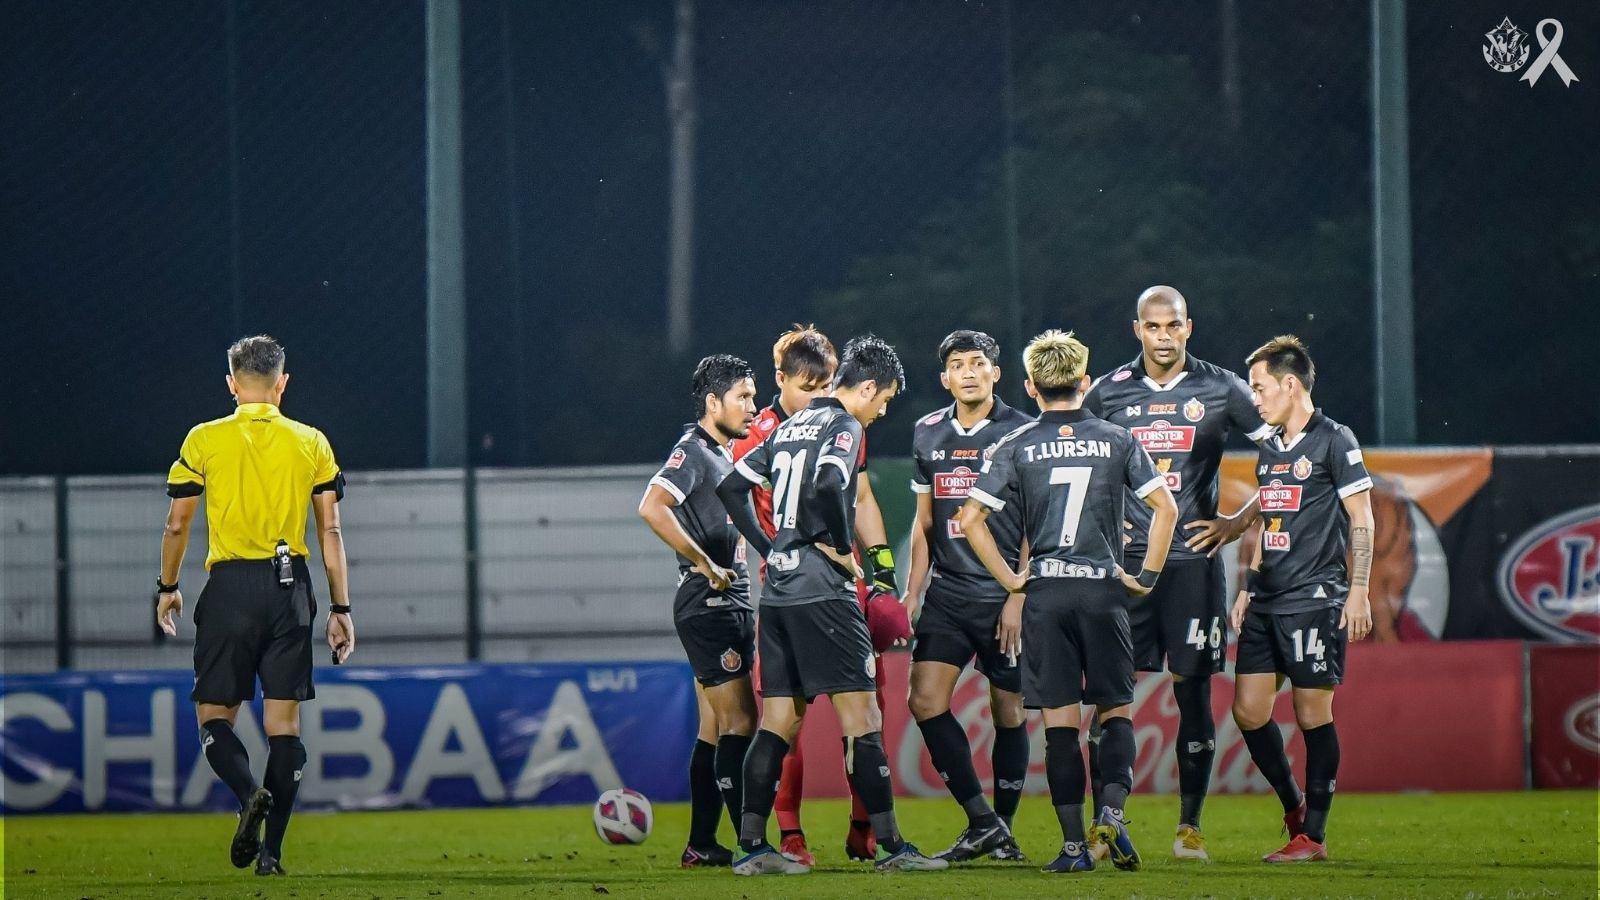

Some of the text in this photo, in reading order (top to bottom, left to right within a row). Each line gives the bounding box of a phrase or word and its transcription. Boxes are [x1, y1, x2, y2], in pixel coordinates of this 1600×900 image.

[1137, 430, 1185, 441] LOBSTER
[1024, 440, 1111, 463] T.LURSAN
[771, 449, 808, 532] 21
[940, 477, 978, 488] LOBSTE
[1049, 466, 1093, 548] 7
[1262, 490, 1293, 501] LOBSTER
[1267, 535, 1288, 547] LEO
[1185, 616, 1221, 650] 46
[1292, 628, 1326, 662] 14
